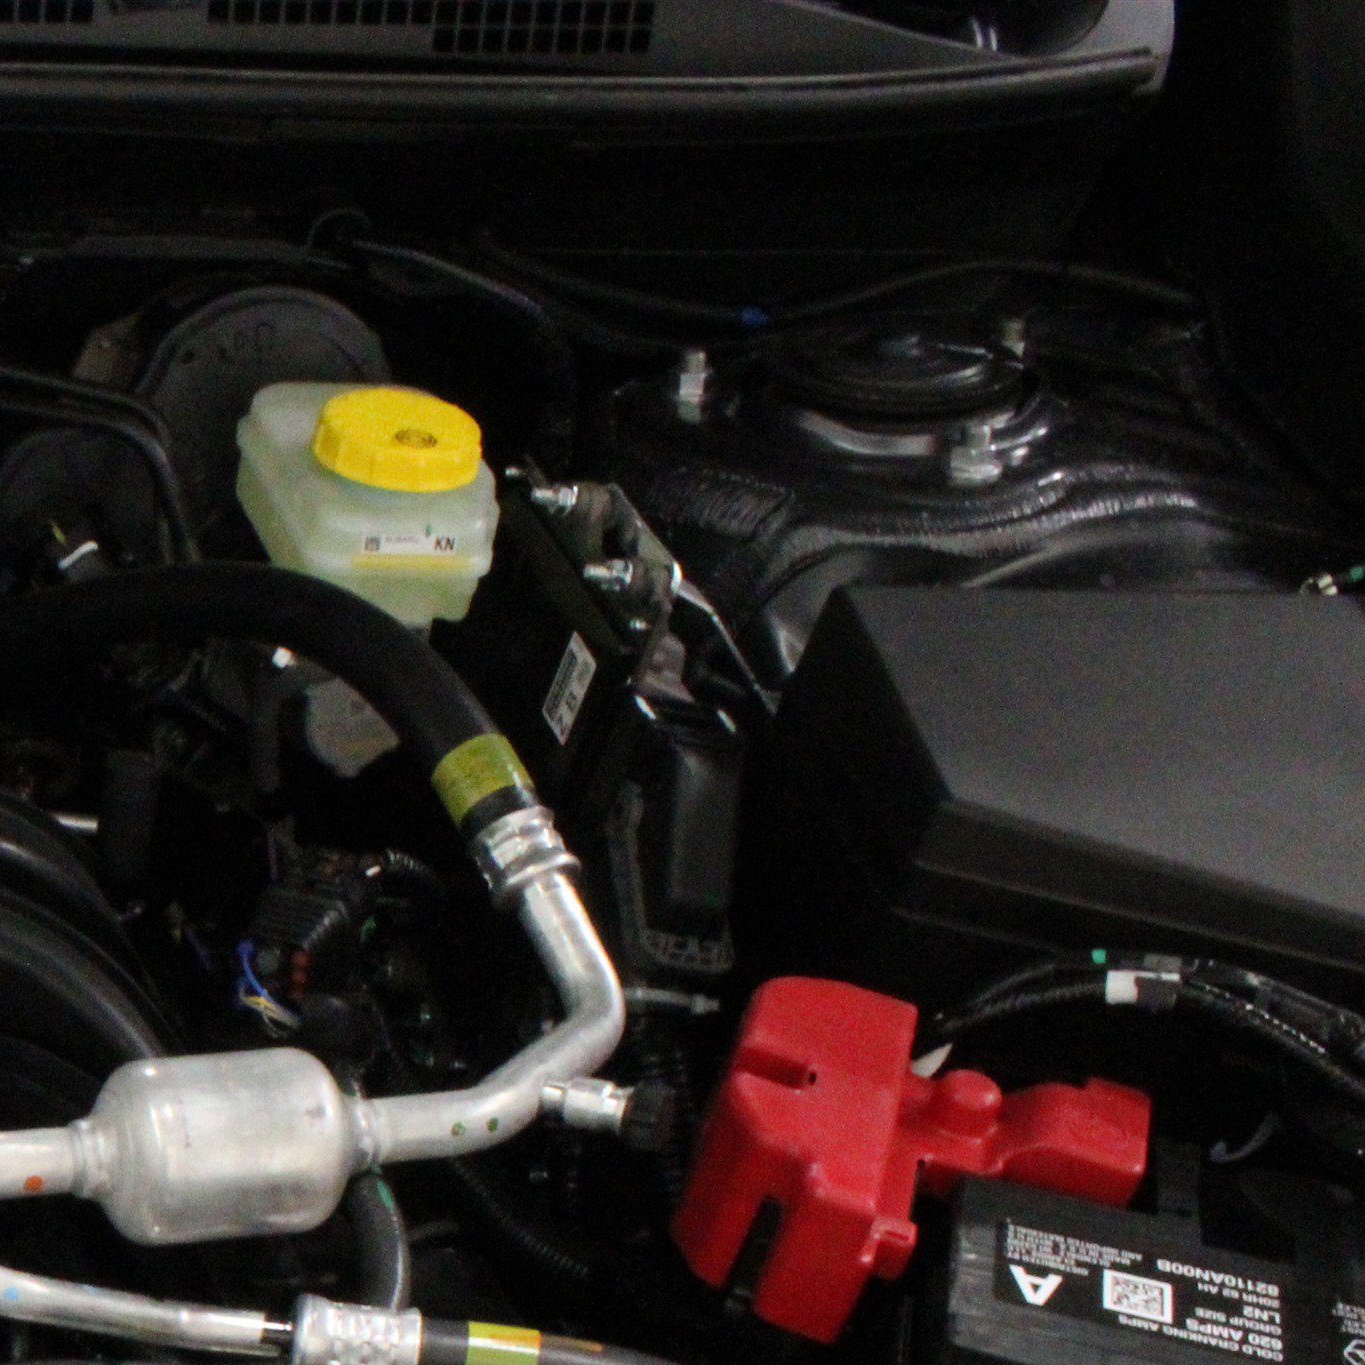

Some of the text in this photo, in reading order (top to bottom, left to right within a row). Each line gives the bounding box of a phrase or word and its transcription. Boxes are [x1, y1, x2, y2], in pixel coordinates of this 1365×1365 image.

[434, 536, 456, 552] KN
[1186, 1317, 1283, 1351] 620 AMPS
[1194, 1307, 1282, 1336] GROUP SIZE
[1118, 1314, 1284, 1363] COLD CRANKING AMPS
